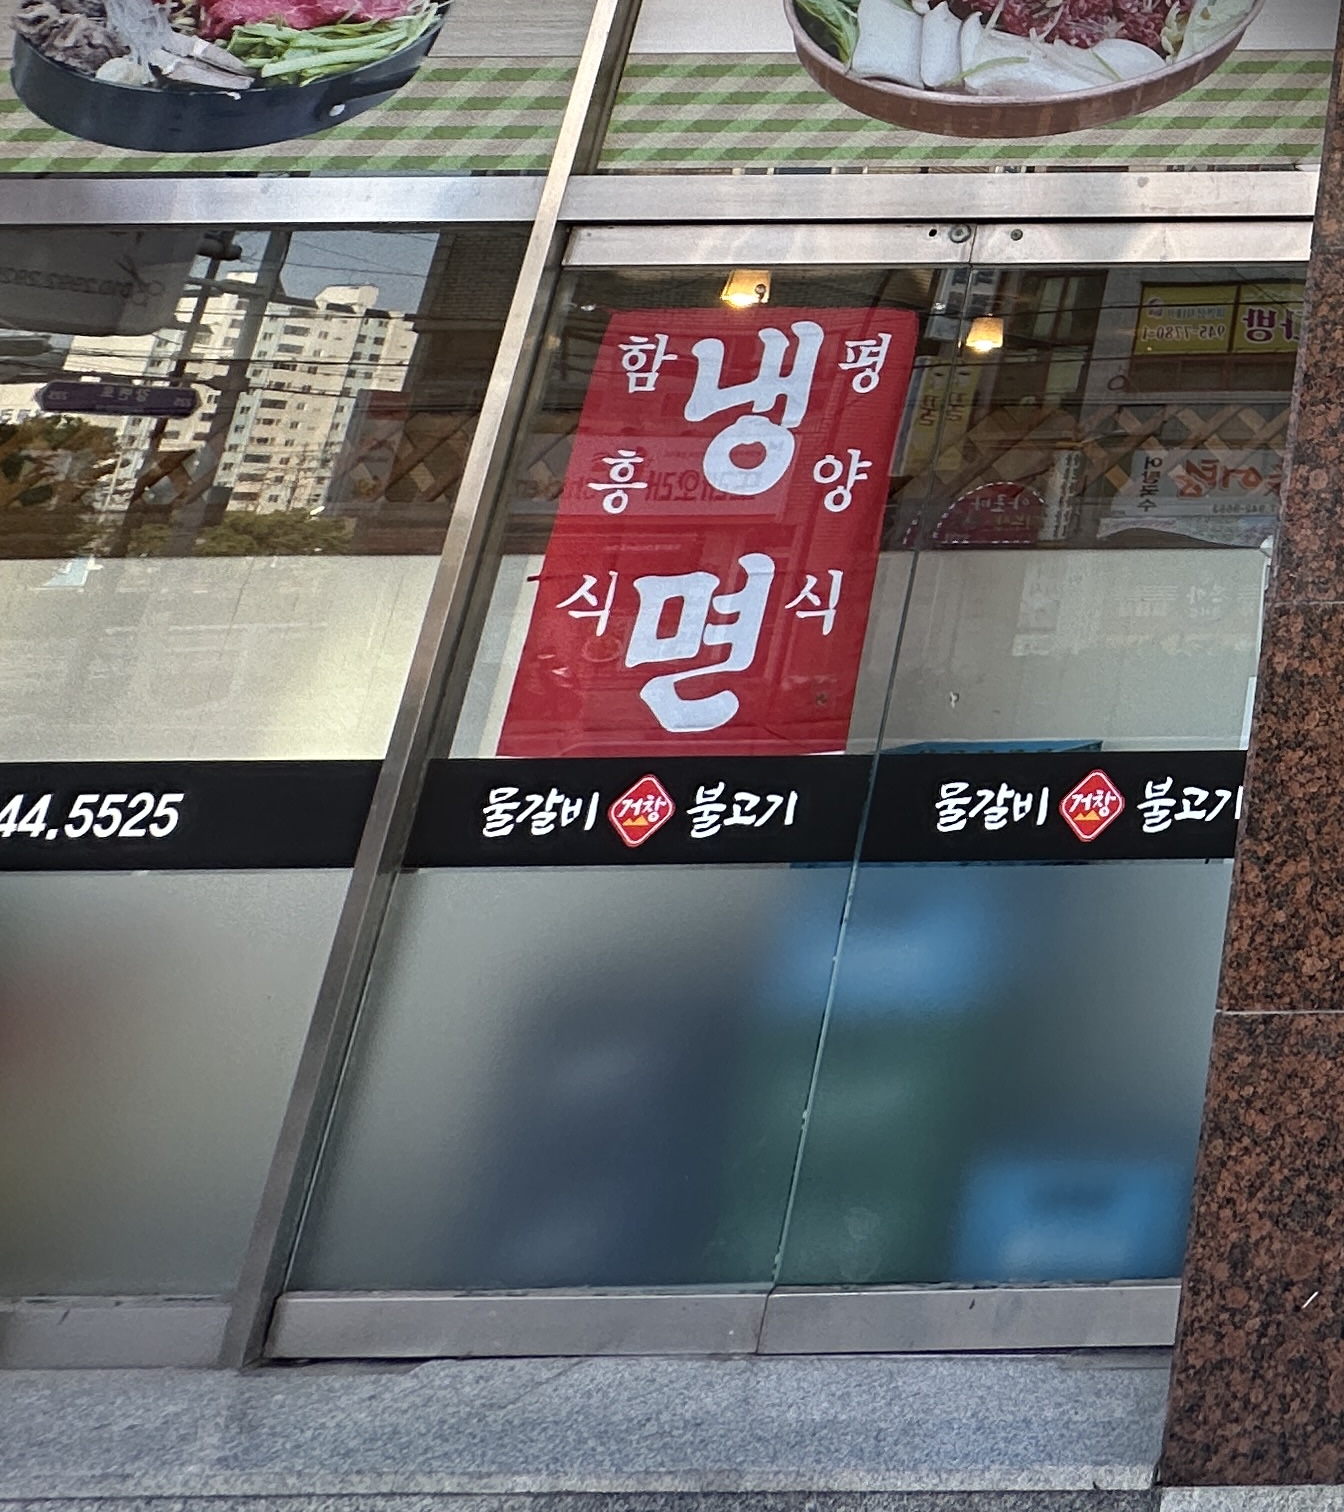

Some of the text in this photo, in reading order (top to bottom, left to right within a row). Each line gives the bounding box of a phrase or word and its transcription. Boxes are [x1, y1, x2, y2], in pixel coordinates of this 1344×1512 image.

[0, 792, 185, 840] 44.5525
[481, 782, 799, 838] 물갈비 거창 불고기
[935, 776, 1244, 833] 물갈비 거창 불고기
